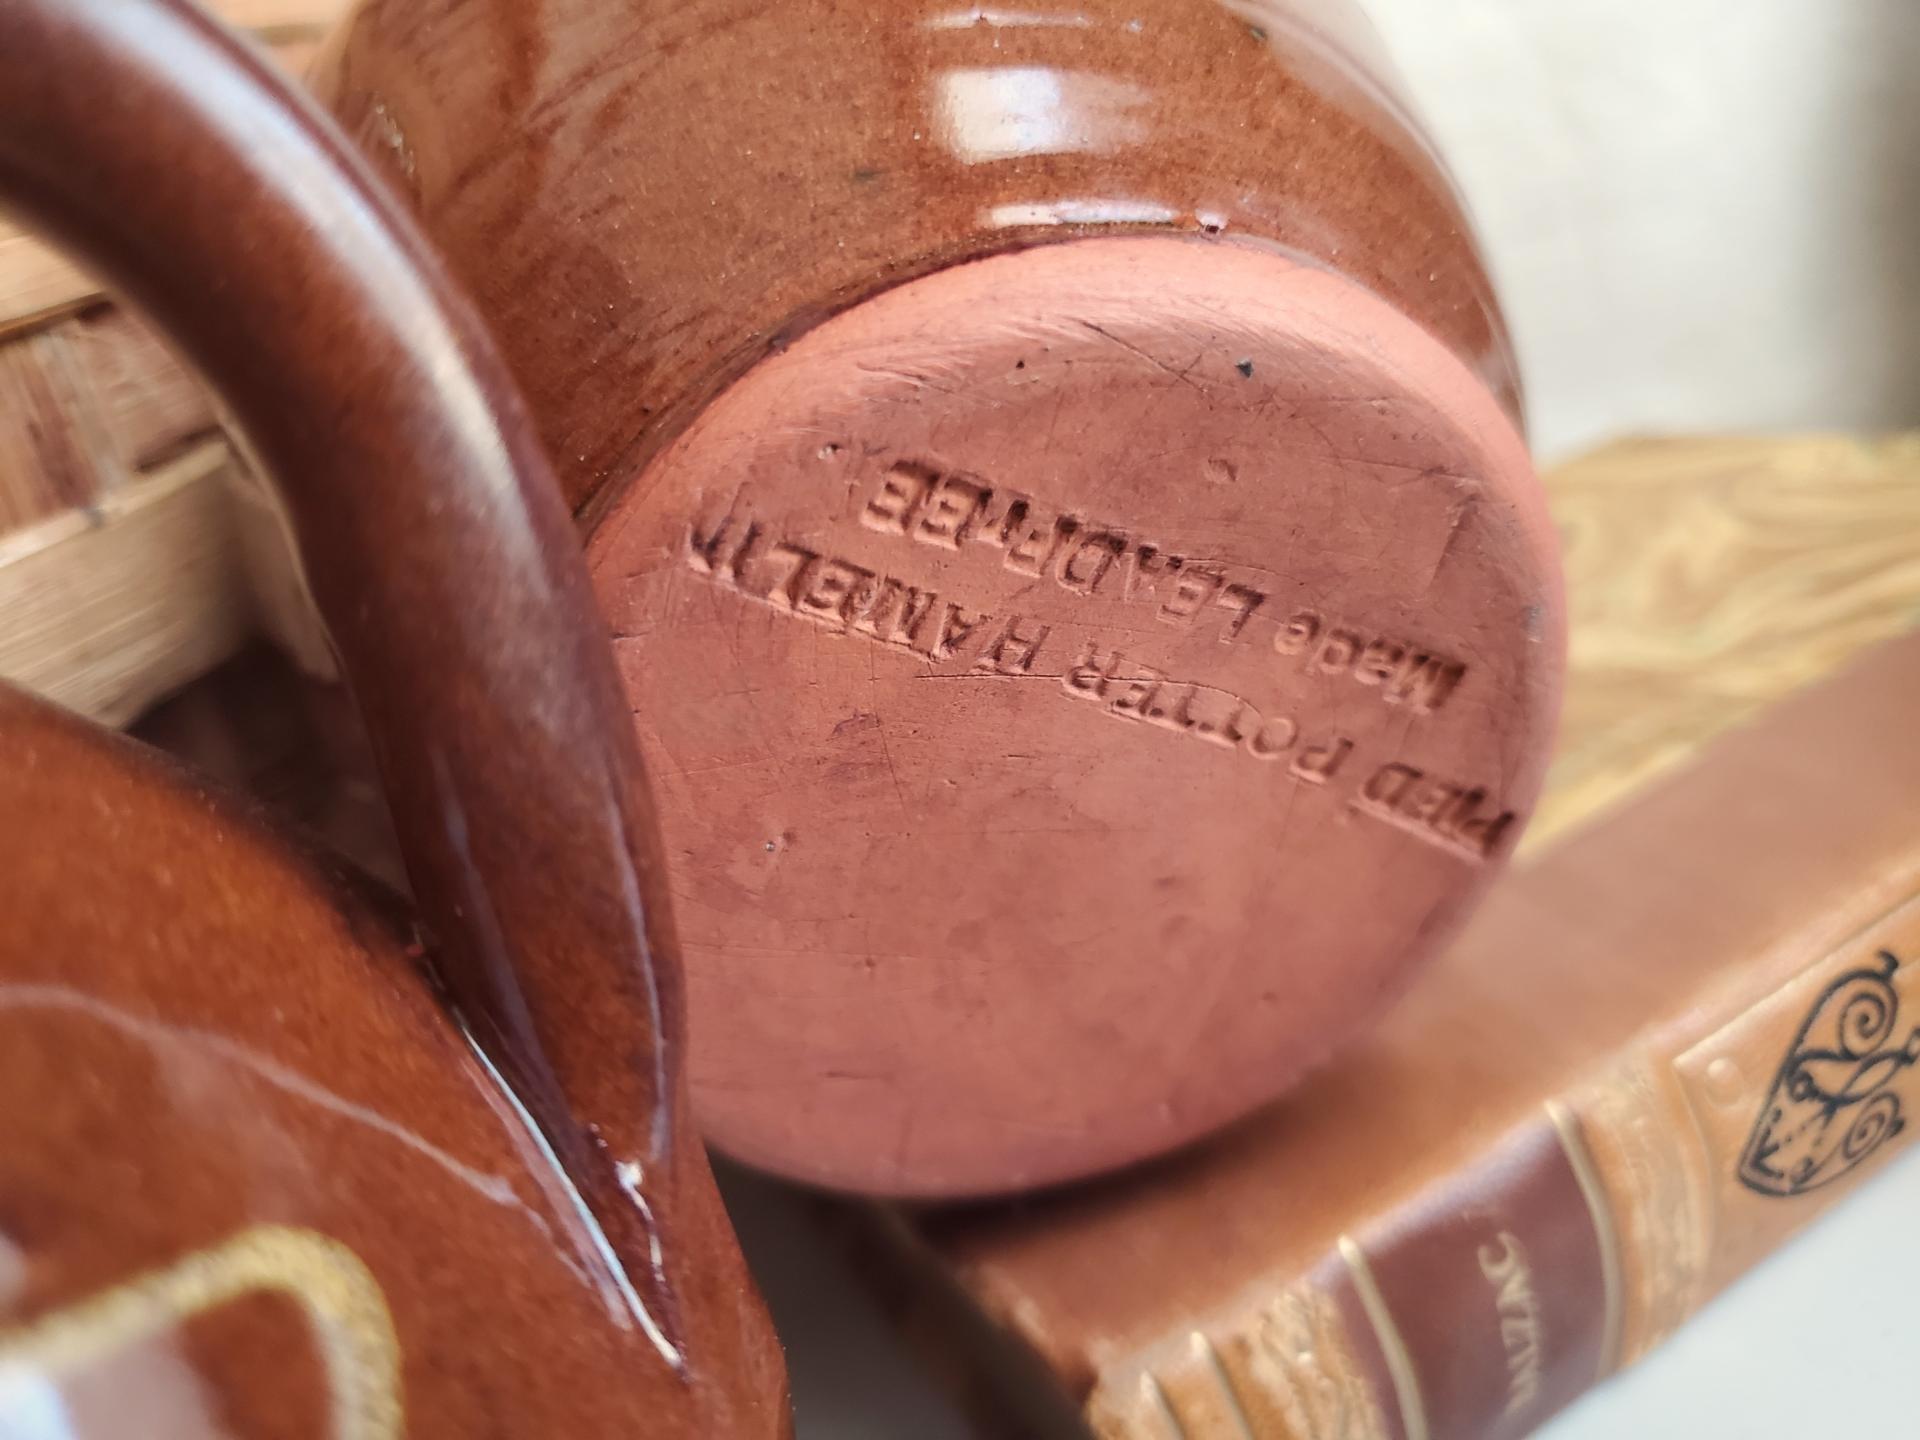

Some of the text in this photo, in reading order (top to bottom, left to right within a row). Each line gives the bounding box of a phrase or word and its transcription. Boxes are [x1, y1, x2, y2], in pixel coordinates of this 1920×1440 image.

[1065, 640, 1355, 787] POTTER
[1273, 609, 1470, 715] Made
[1362, 761, 1518, 860] PIED
